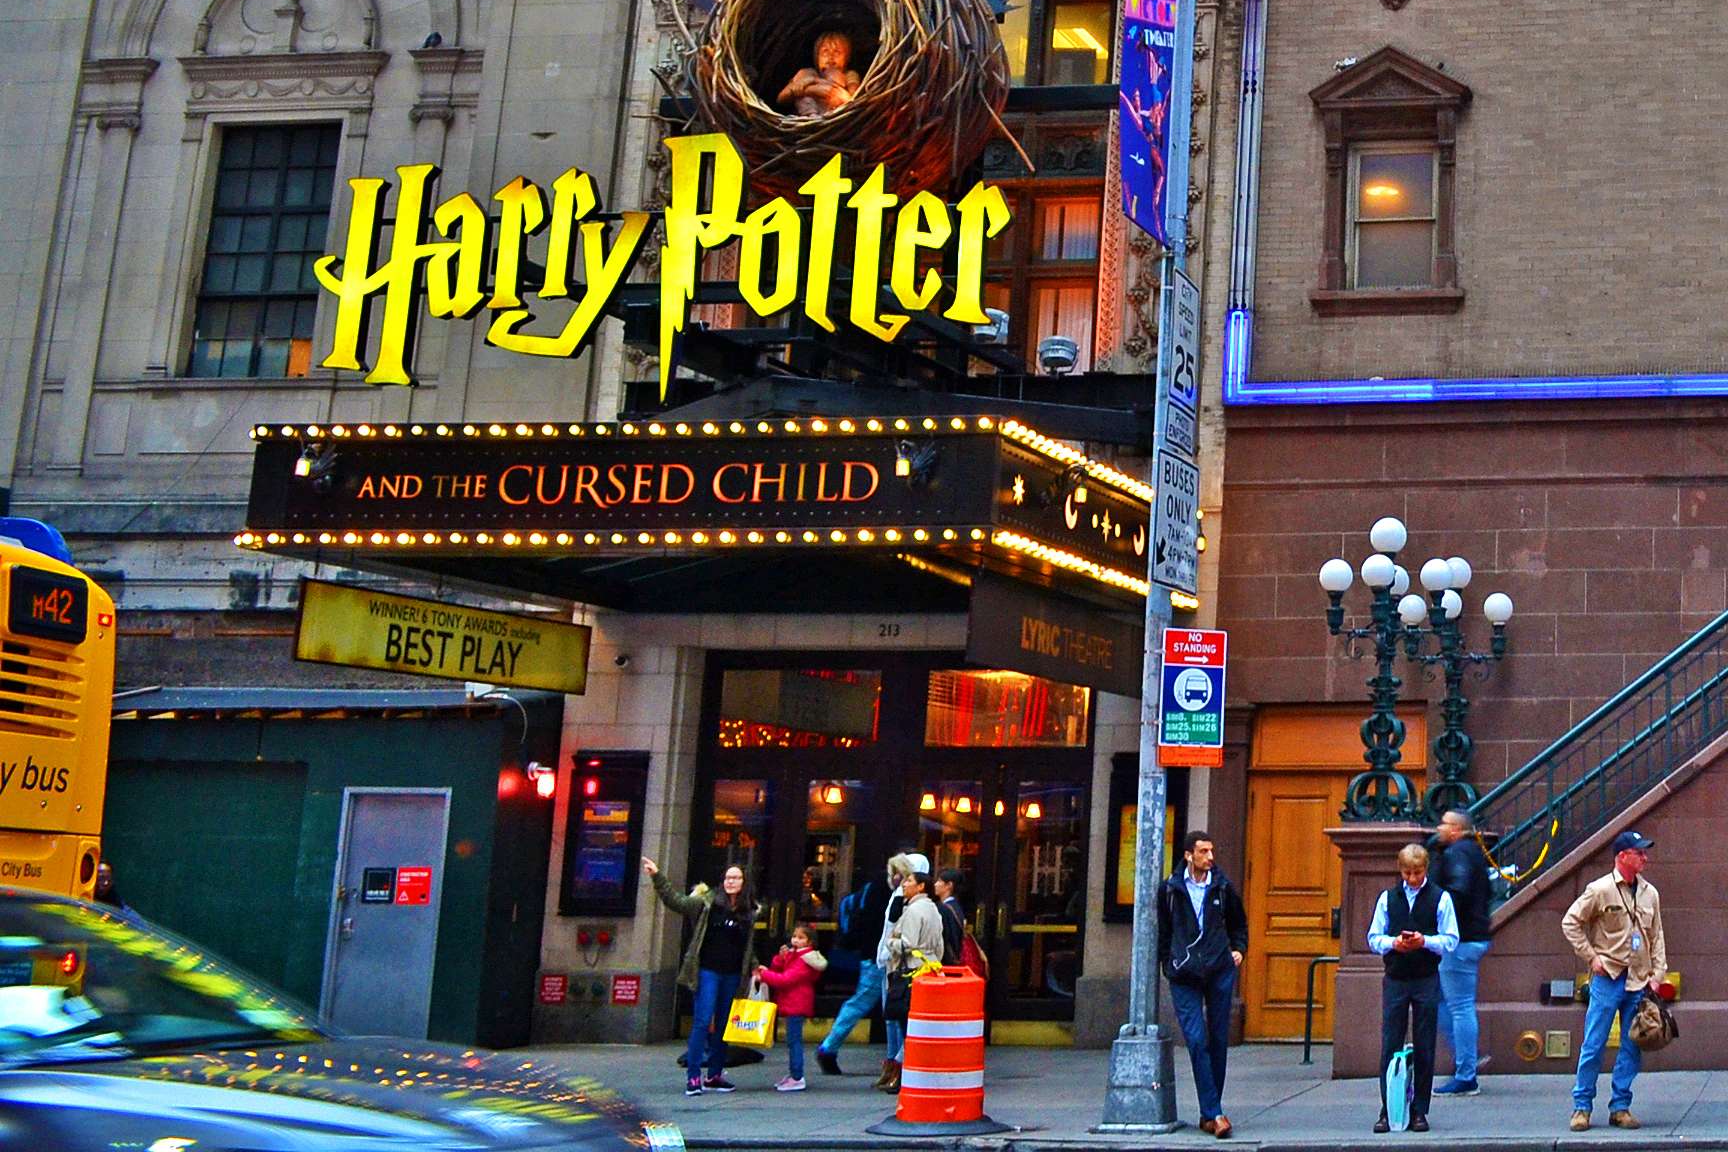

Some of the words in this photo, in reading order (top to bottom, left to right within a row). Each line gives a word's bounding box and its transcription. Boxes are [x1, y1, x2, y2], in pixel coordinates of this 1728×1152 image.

[314, 162, 649, 386] Harry
[658, 133, 1013, 401] Potter
[1174, 345, 1195, 399] 25
[356, 474, 424, 500] AND
[431, 473, 488, 499] THE
[497, 463, 696, 509] CURSED
[712, 460, 880, 503] CHILD
[1164, 460, 1195, 497] BUSES
[1166, 494, 1192, 525] ONLY
[33, 587, 74, 626] M42
[369, 599, 421, 624] WINNER!
[421, 612, 428, 625] 6
[430, 610, 464, 628] TONY
[464, 616, 510, 639] AWARDS
[879, 623, 900, 637] 213
[1021, 615, 1061, 658] LYRIC
[1173, 642, 1217, 654] STANDING
[1188, 632, 1202, 642] NO
[384, 623, 454, 668] BEST
[458, 634, 524, 678] PLAY
[20, 755, 70, 793] bus
[1, 861, 22, 879] City
[24, 863, 42, 878] Bus
